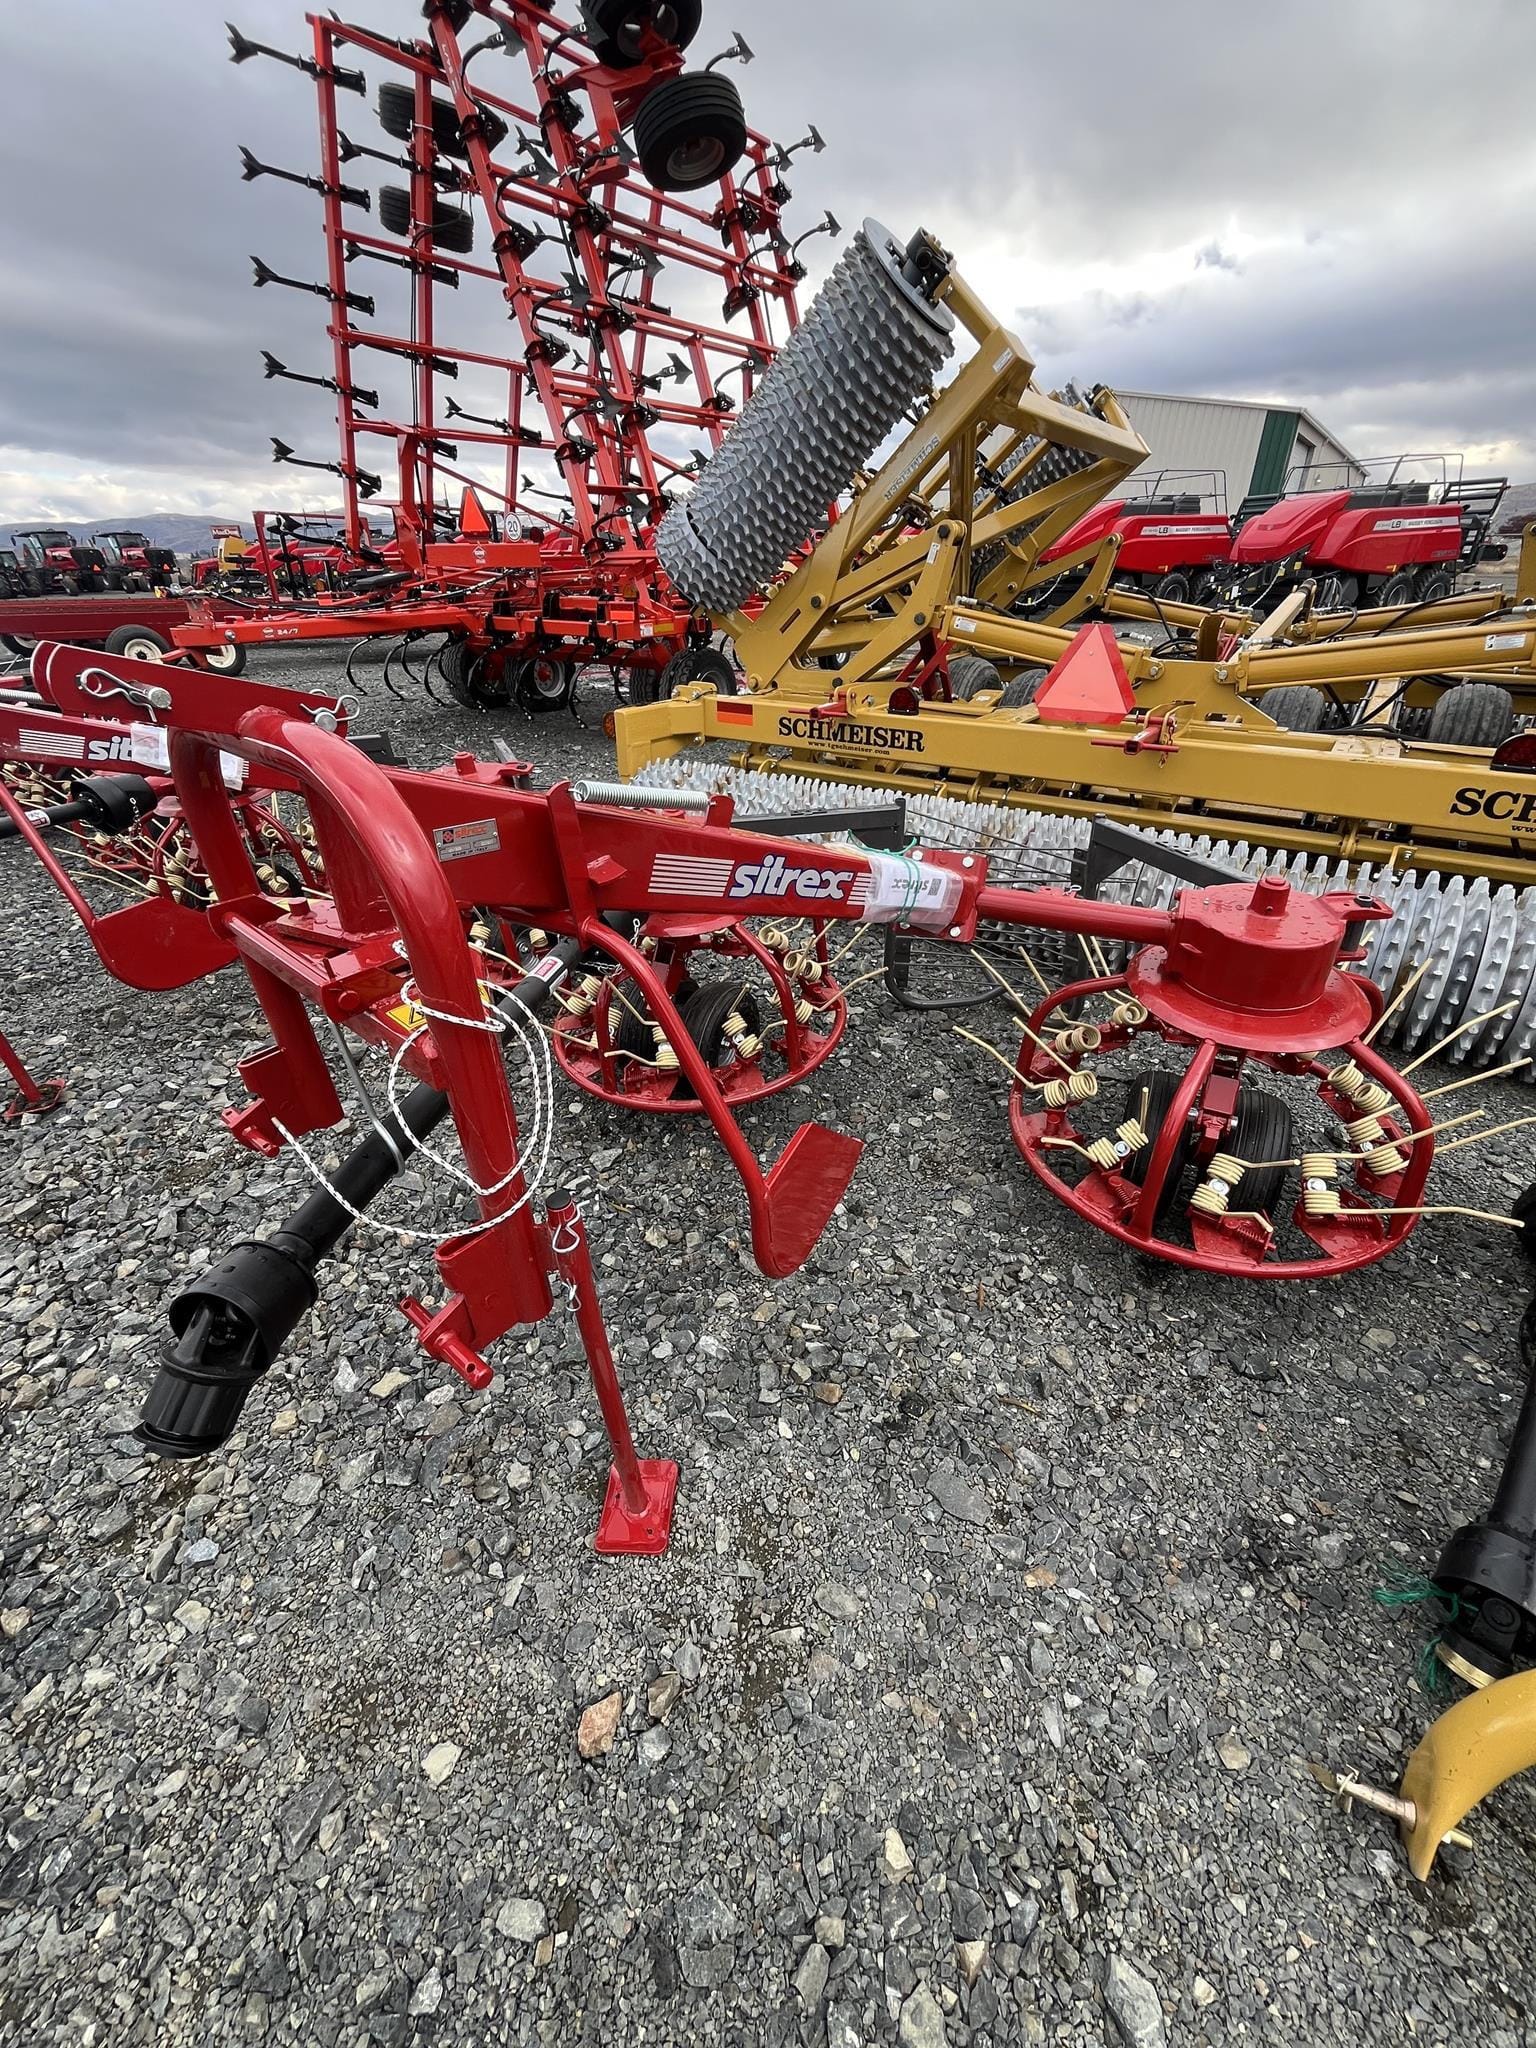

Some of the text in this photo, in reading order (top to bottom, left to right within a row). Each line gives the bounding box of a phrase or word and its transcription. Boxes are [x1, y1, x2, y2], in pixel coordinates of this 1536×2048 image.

[884, 435, 939, 500] SCHMEISER
[507, 520, 518, 532] 20
[1158, 526, 1169, 534] LB
[778, 716, 925, 752] SCHMEISER
[87, 735, 133, 761] sit
[808, 740, 890, 755] www.tgschmeiser.com
[728, 854, 854, 899] sitrex
